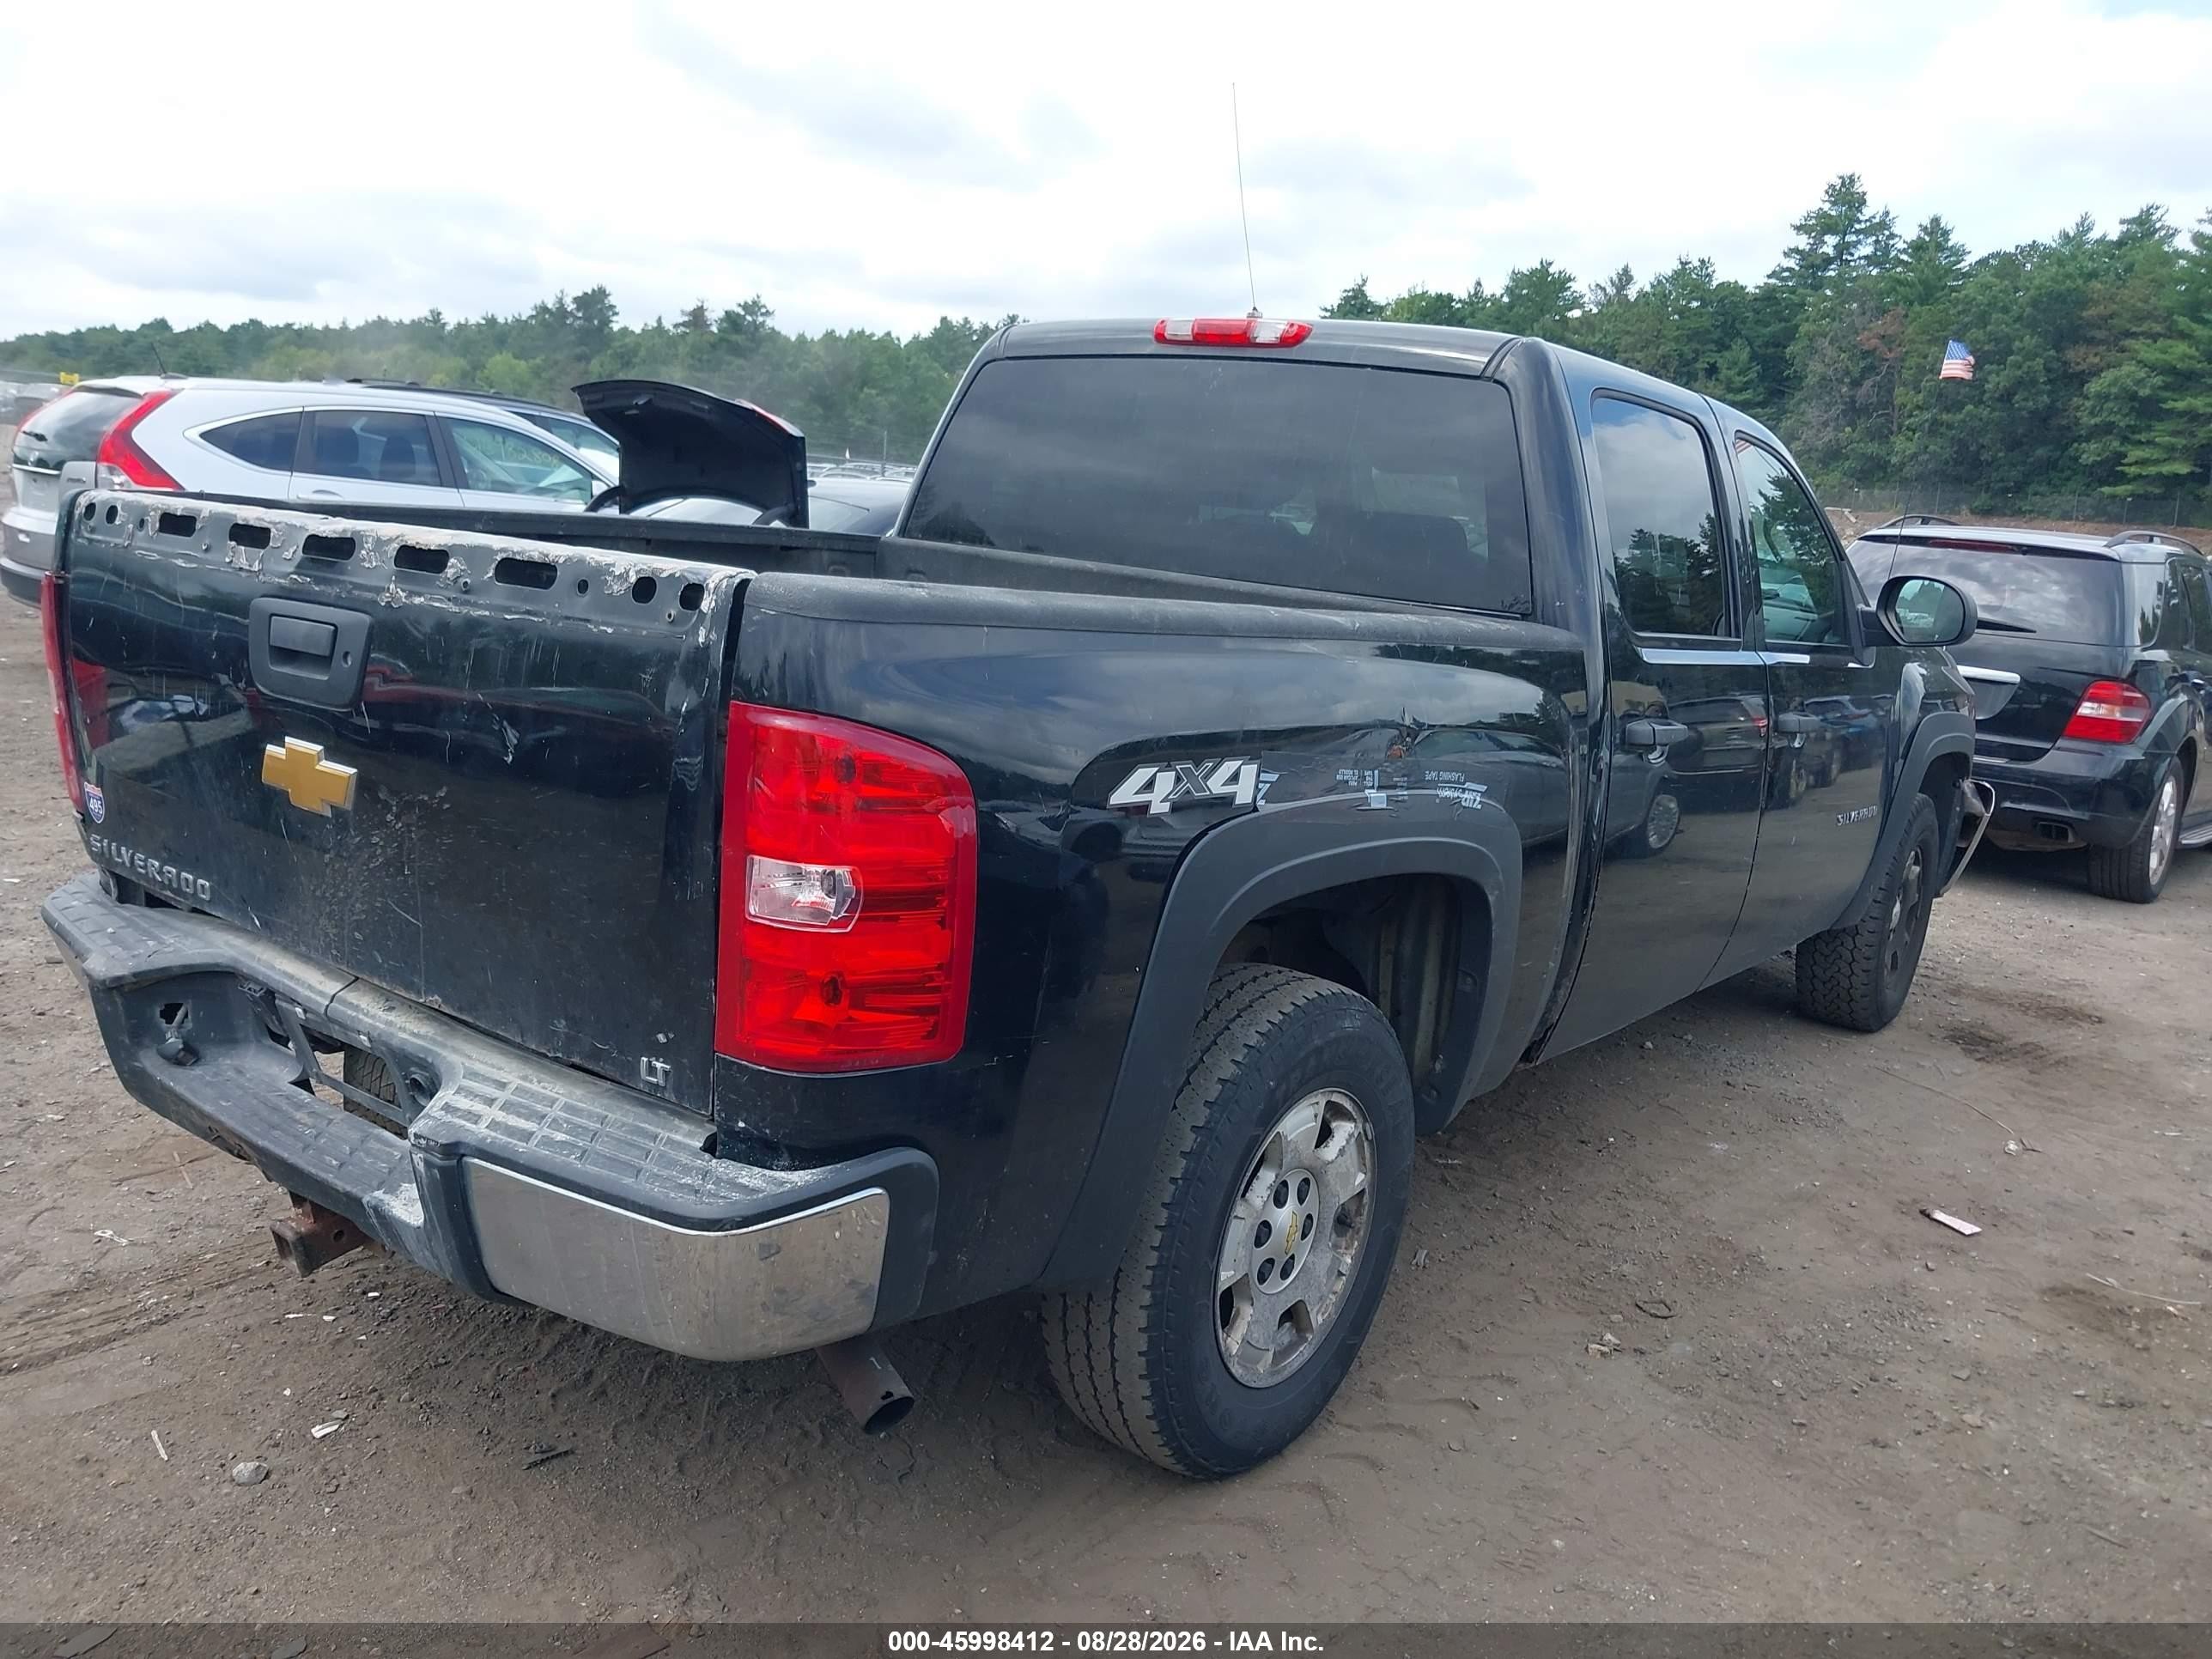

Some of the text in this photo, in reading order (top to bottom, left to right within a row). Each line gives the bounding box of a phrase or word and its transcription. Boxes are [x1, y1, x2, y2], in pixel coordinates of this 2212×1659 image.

[1425, 770, 1465, 782] FLASHING TAPE
[88, 796, 103, 815] 495
[1837, 805, 1878, 826] SILVERADO
[89, 833, 211, 901] SILVERADO
[640, 1056, 672, 1087] LT
